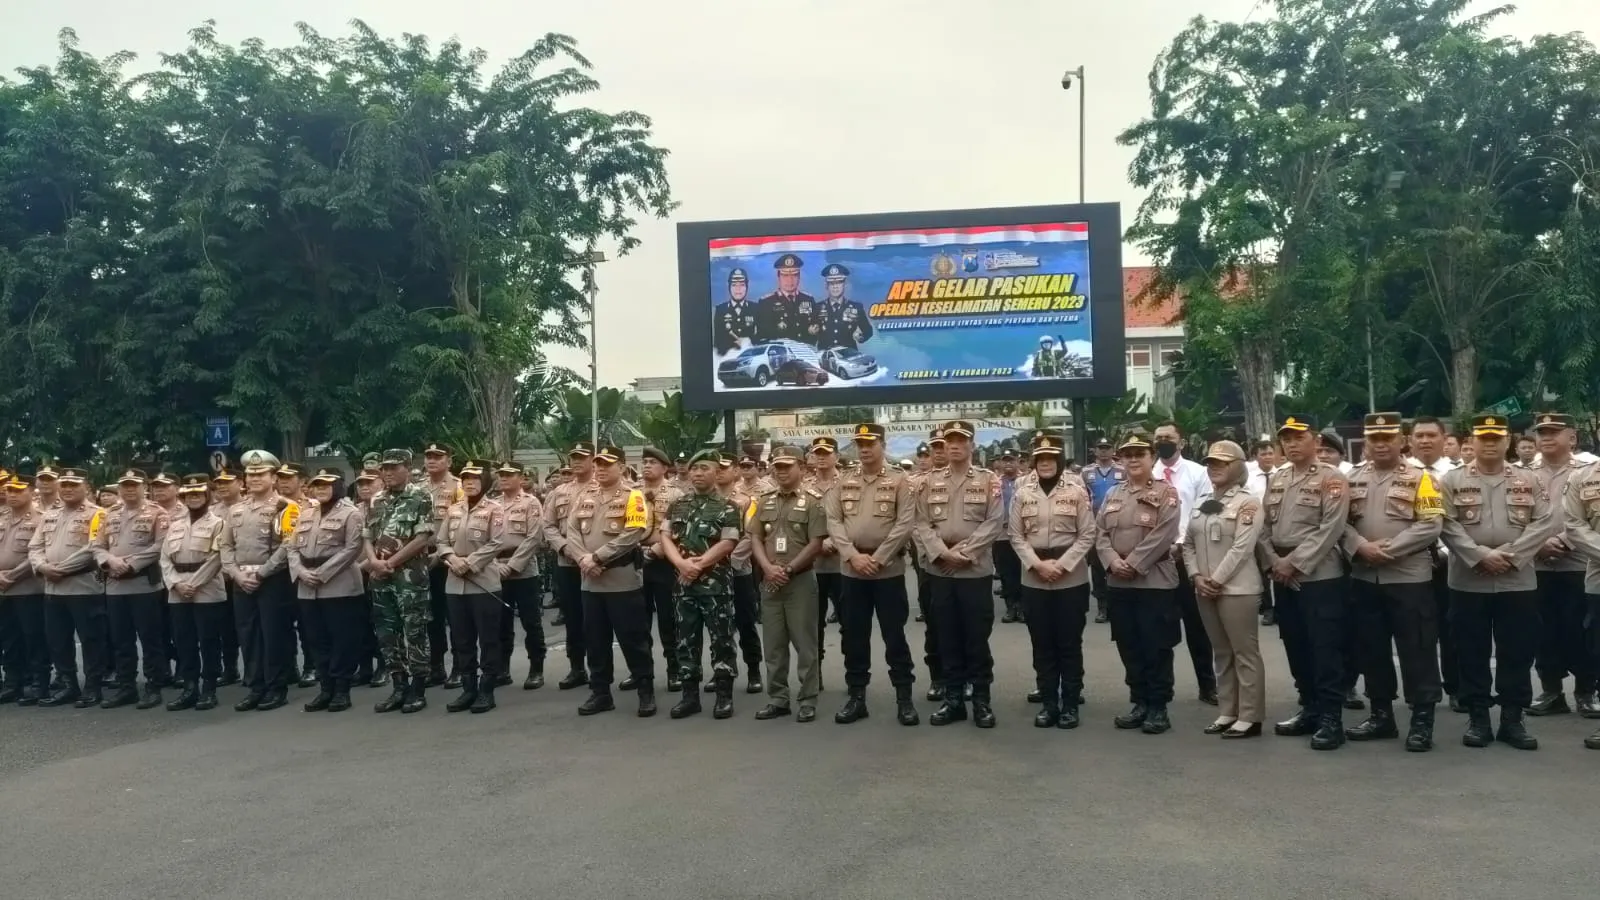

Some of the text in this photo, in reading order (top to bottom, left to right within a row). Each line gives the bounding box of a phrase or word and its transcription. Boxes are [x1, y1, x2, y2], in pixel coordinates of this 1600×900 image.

[888, 274, 1075, 300] APEL GELAR PASUKAN
[869, 295, 1085, 317] OPERASI KESELAMATAN SEMERU 2023
[214, 427, 223, 438] A
